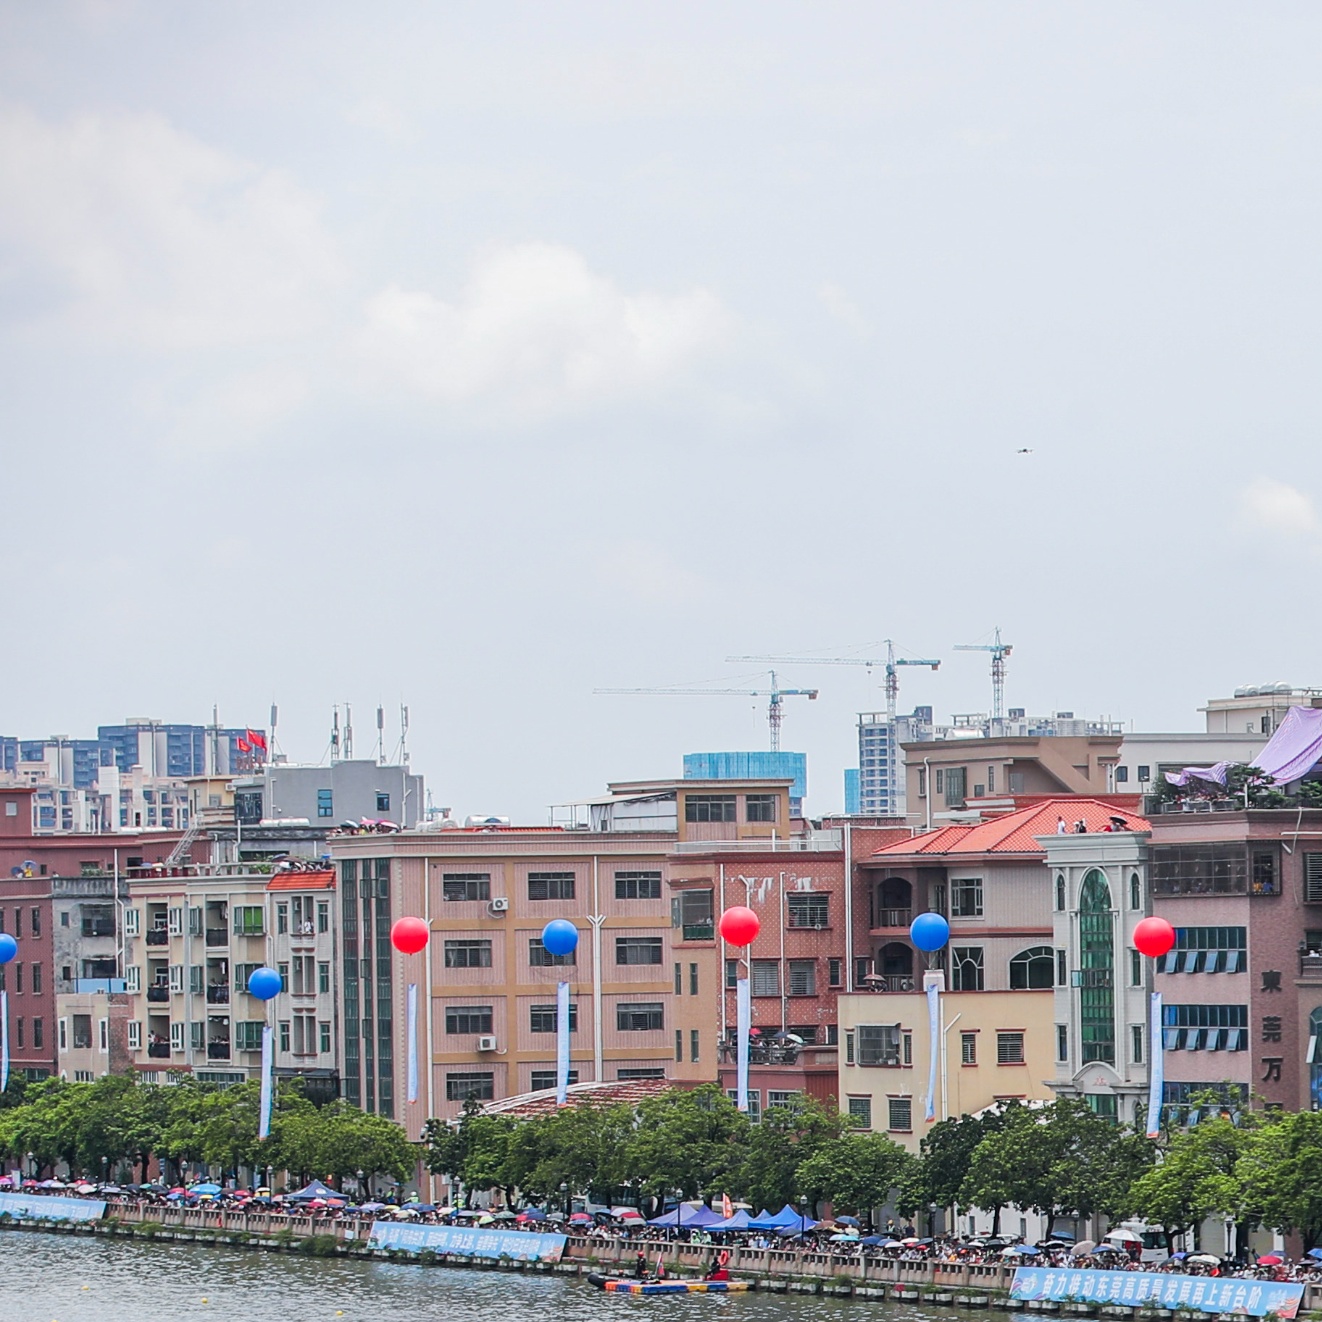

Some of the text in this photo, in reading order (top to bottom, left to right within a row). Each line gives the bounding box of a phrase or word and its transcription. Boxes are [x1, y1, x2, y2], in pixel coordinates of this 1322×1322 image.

[1042, 1273, 1263, 1309] 奋力推动东莞高质量发展再上新台阶
